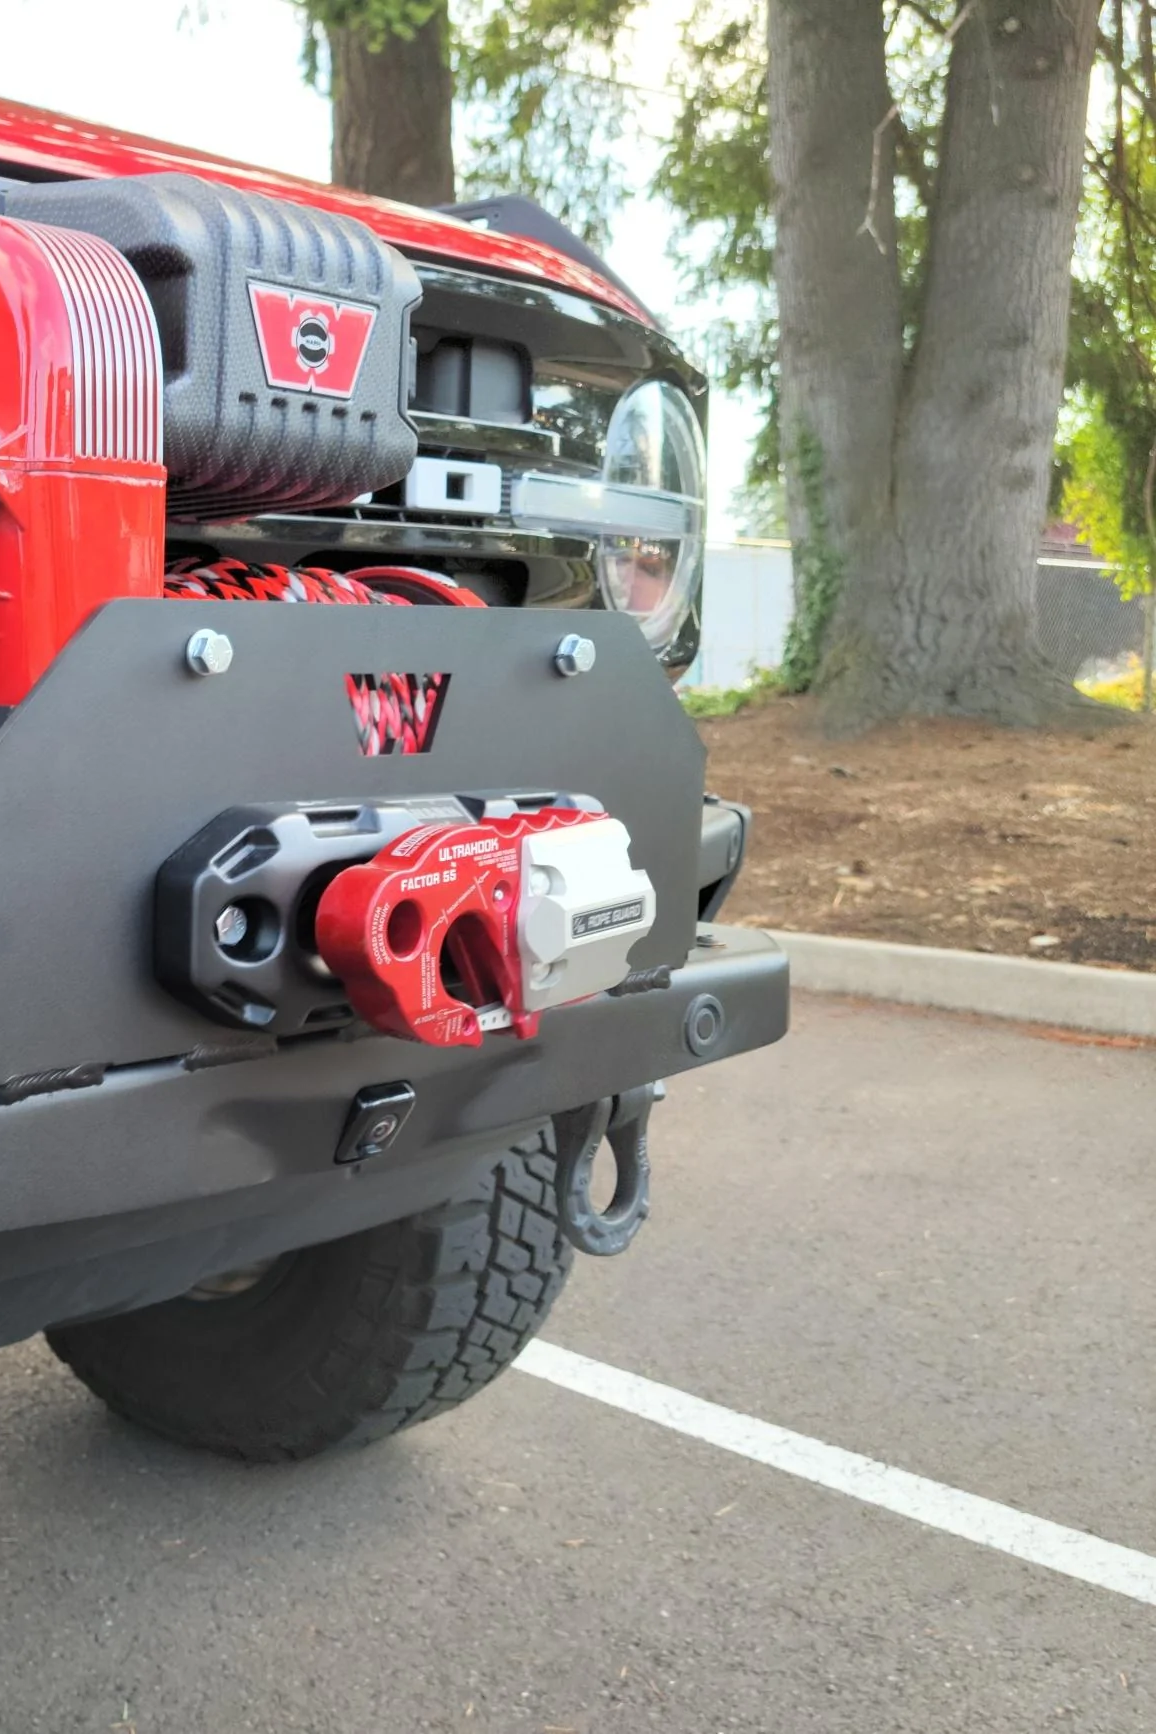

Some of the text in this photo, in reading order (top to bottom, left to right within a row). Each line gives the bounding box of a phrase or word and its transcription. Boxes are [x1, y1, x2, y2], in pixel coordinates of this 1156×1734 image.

[438, 838, 499, 862] ULTRAHOOK
[400, 872, 440, 892] FACTOR
[378, 902, 390, 932] MOUNT
[587, 911, 612, 929] ROPE
[612, 904, 642, 923] GUARD
